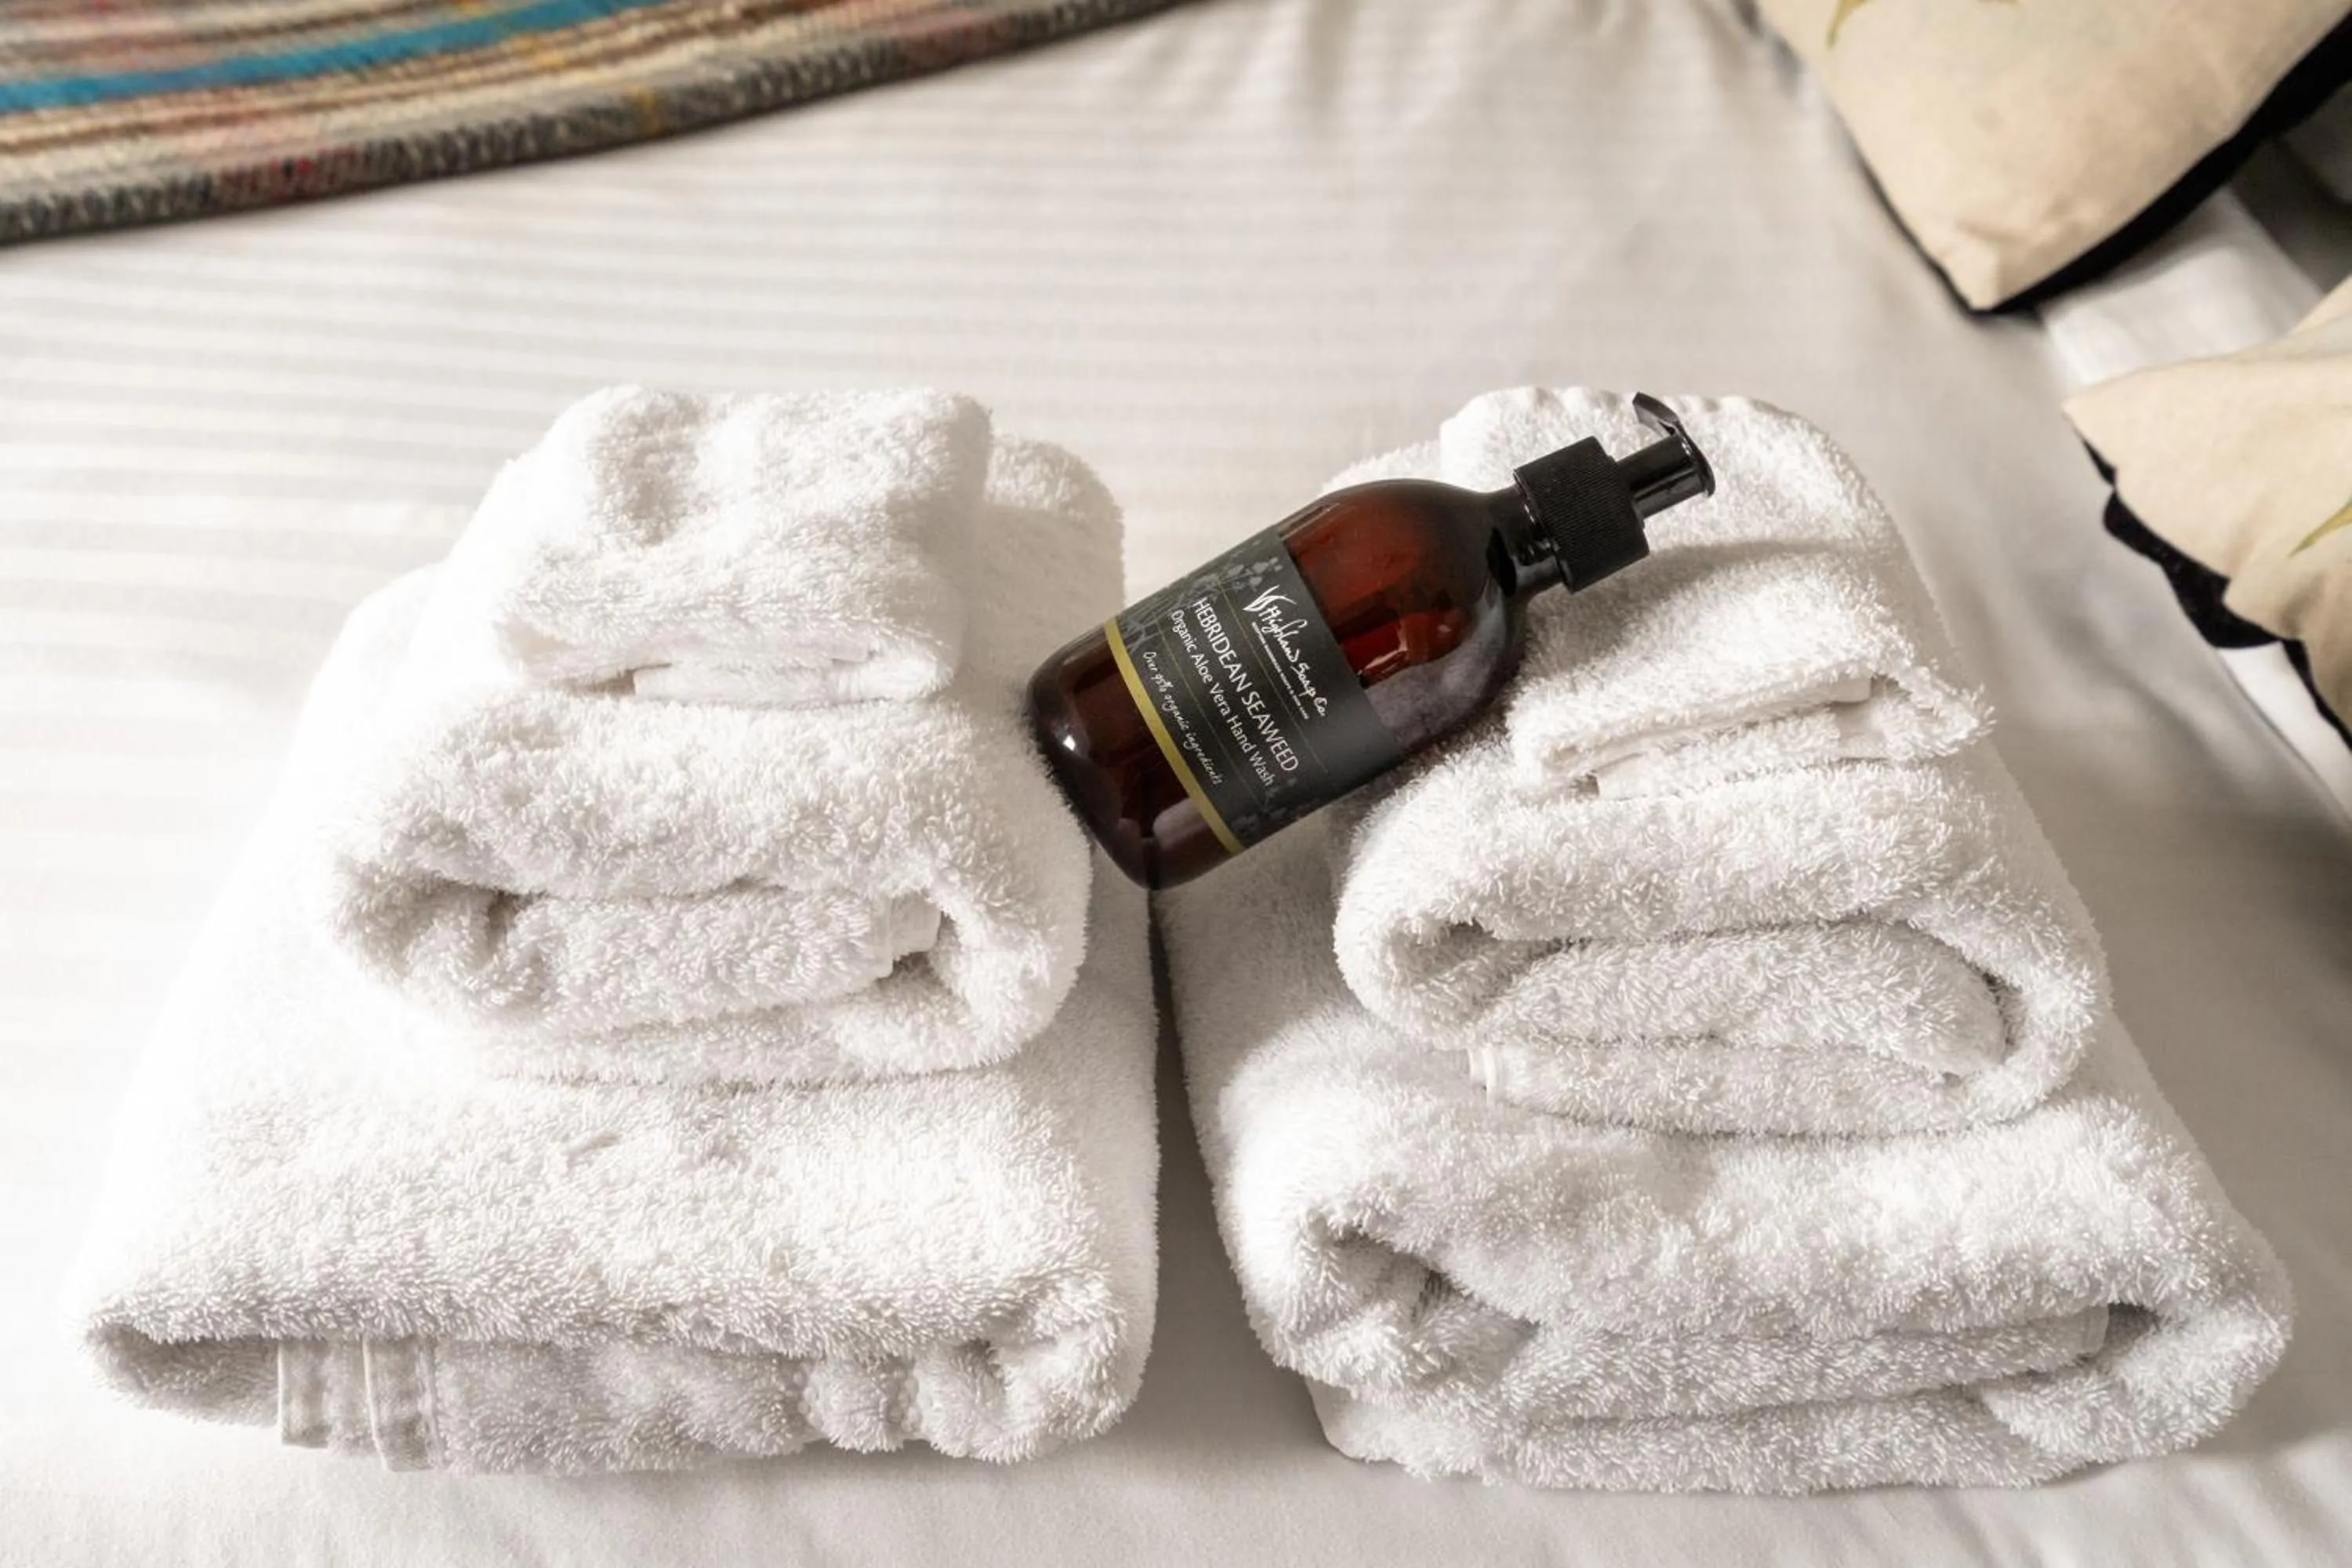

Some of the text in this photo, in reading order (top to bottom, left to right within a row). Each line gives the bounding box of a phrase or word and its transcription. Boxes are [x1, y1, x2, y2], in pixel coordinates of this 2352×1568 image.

[1142, 652, 1159, 672] Over
[1161, 694, 1189, 731] organic
[1182, 732, 1222, 785] ingredients
[1167, 609, 1276, 786] Organic Aloe Vera Hand Wash
[1191, 596, 1253, 693] HEBRIDEAN
[1241, 691, 1299, 771] SEAWEED
[1290, 662, 1316, 698] Soap
